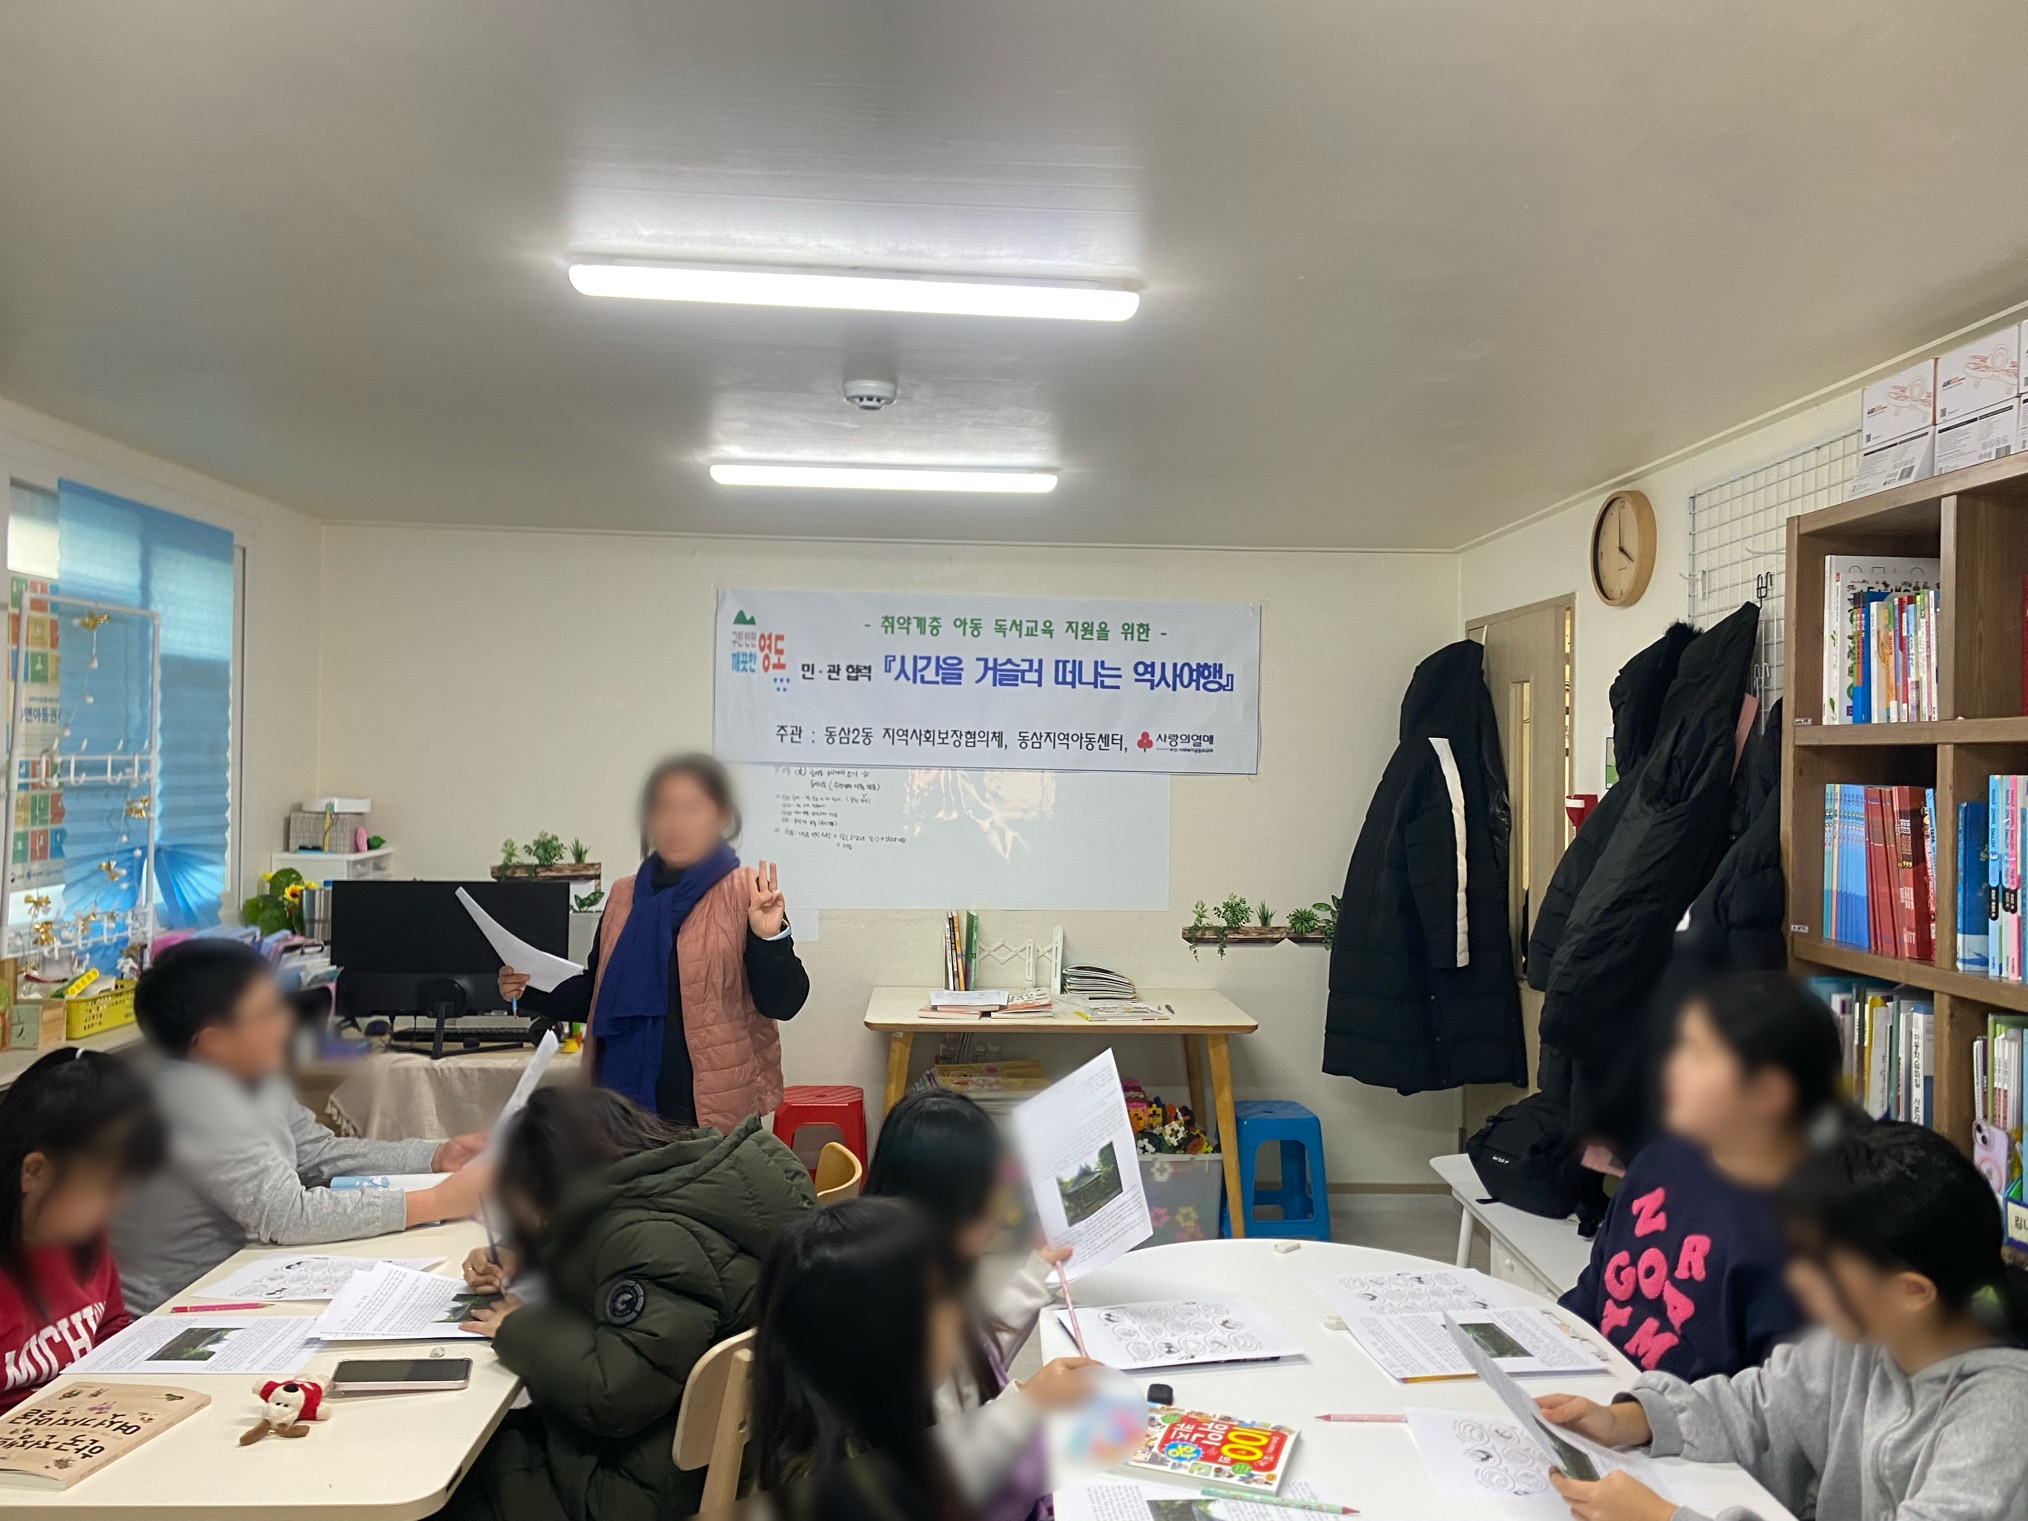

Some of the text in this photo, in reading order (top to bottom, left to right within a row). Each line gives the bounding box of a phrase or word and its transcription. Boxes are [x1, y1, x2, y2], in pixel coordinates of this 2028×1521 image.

[880, 615, 942, 637] 취약계층
[953, 618, 983, 638] 아동
[994, 619, 1054, 639] 독서교육
[1065, 621, 1110, 641] 지원을
[1121, 622, 1151, 642] 위한
[758, 632, 786, 673] 영도
[845, 664, 872, 682] 협력
[884, 654, 964, 686] 『시간을
[974, 657, 1043, 688] 거슬러
[1054, 658, 1122, 690] 떠나는
[1133, 660, 1234, 693] 역사여행』
[775, 724, 803, 744] 주관
[824, 726, 874, 746] 동삼2동
[882, 728, 1008, 750] 지역사회보장협의체,
[1017, 730, 1128, 753] 동삼지역아동센터,
[1155, 733, 1214, 747] 사랑의열매
[1170, 1422, 1195, 1440] 퀴즈
[1191, 1422, 1229, 1446] 위인
